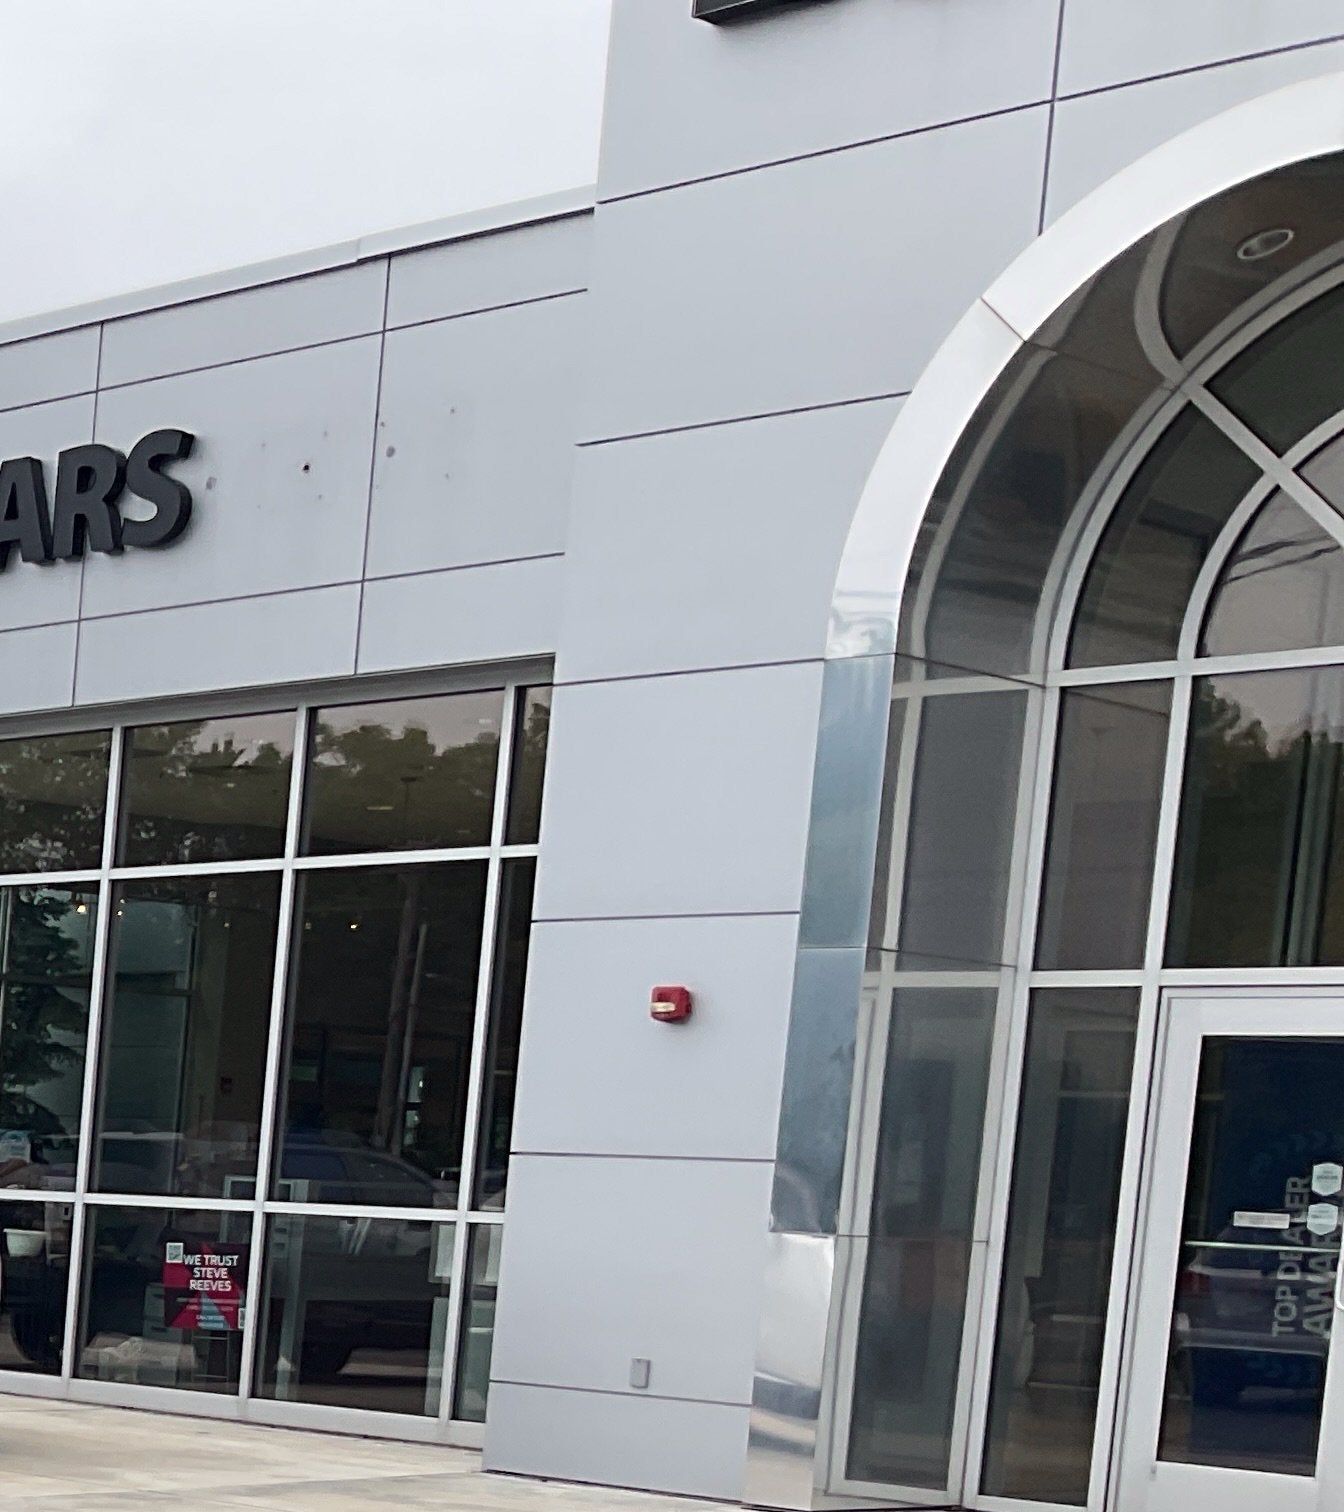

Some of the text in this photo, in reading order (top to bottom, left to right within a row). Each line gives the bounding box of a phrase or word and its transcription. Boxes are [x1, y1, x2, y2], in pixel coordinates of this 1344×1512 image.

[183, 1254, 239, 1267] WE TRUST
[193, 1267, 229, 1279] STEVE
[189, 1279, 232, 1292] REEVES
[1272, 1284, 1299, 1337] TOP
